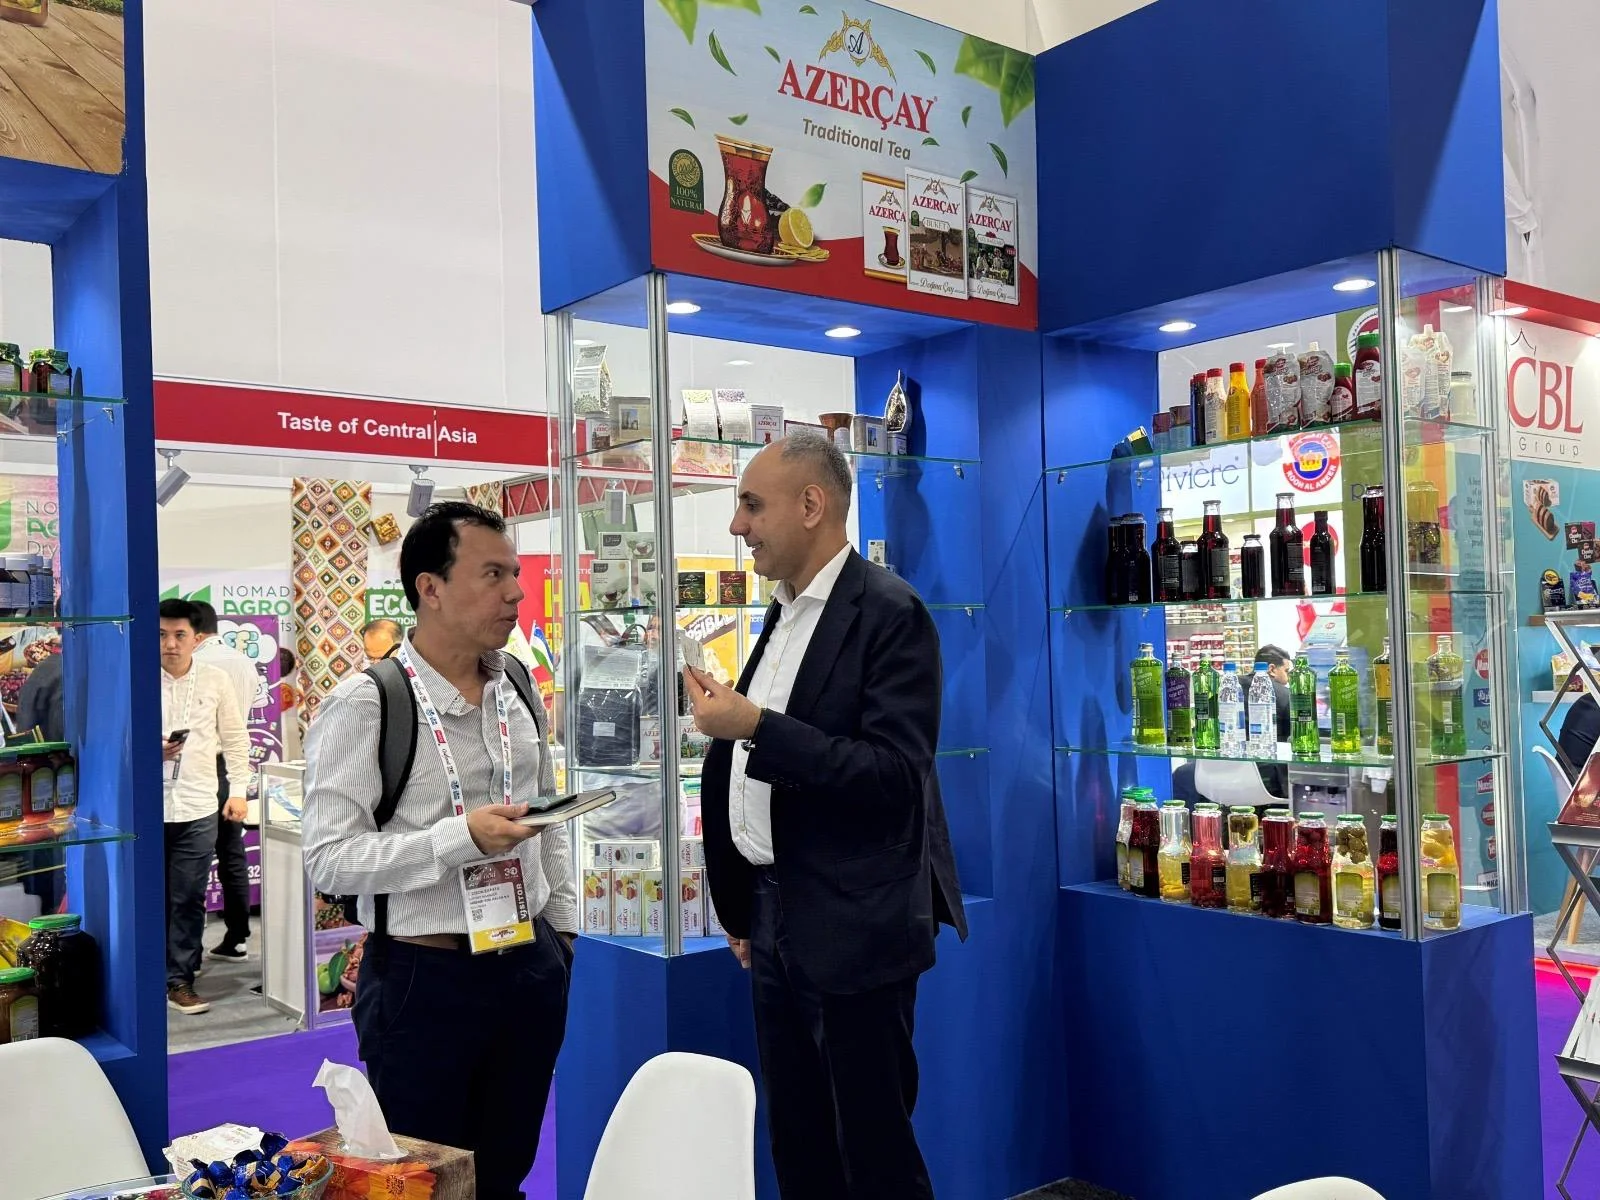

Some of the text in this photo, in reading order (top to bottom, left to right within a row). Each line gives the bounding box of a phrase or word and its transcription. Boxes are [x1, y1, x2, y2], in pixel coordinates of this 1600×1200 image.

[777, 58, 934, 135] AZERÇAY
[802, 118, 912, 161] Traditional Tea
[676, 186, 698, 198] 100%
[670, 196, 703, 211] NATURAL
[868, 205, 906, 222] AZERÇA
[912, 195, 960, 215] AZERÇAY
[968, 212, 1013, 233] AZERÇAY
[1508, 356, 1584, 434] CBL
[277, 411, 477, 444] Taste of Central Asia
[1518, 436, 1579, 459] Group
[1160, 461, 1240, 492] ivière
[223, 585, 290, 597] NOMAD
[223, 599, 292, 616] AGRO
[516, 883, 528, 919] VISITOR
